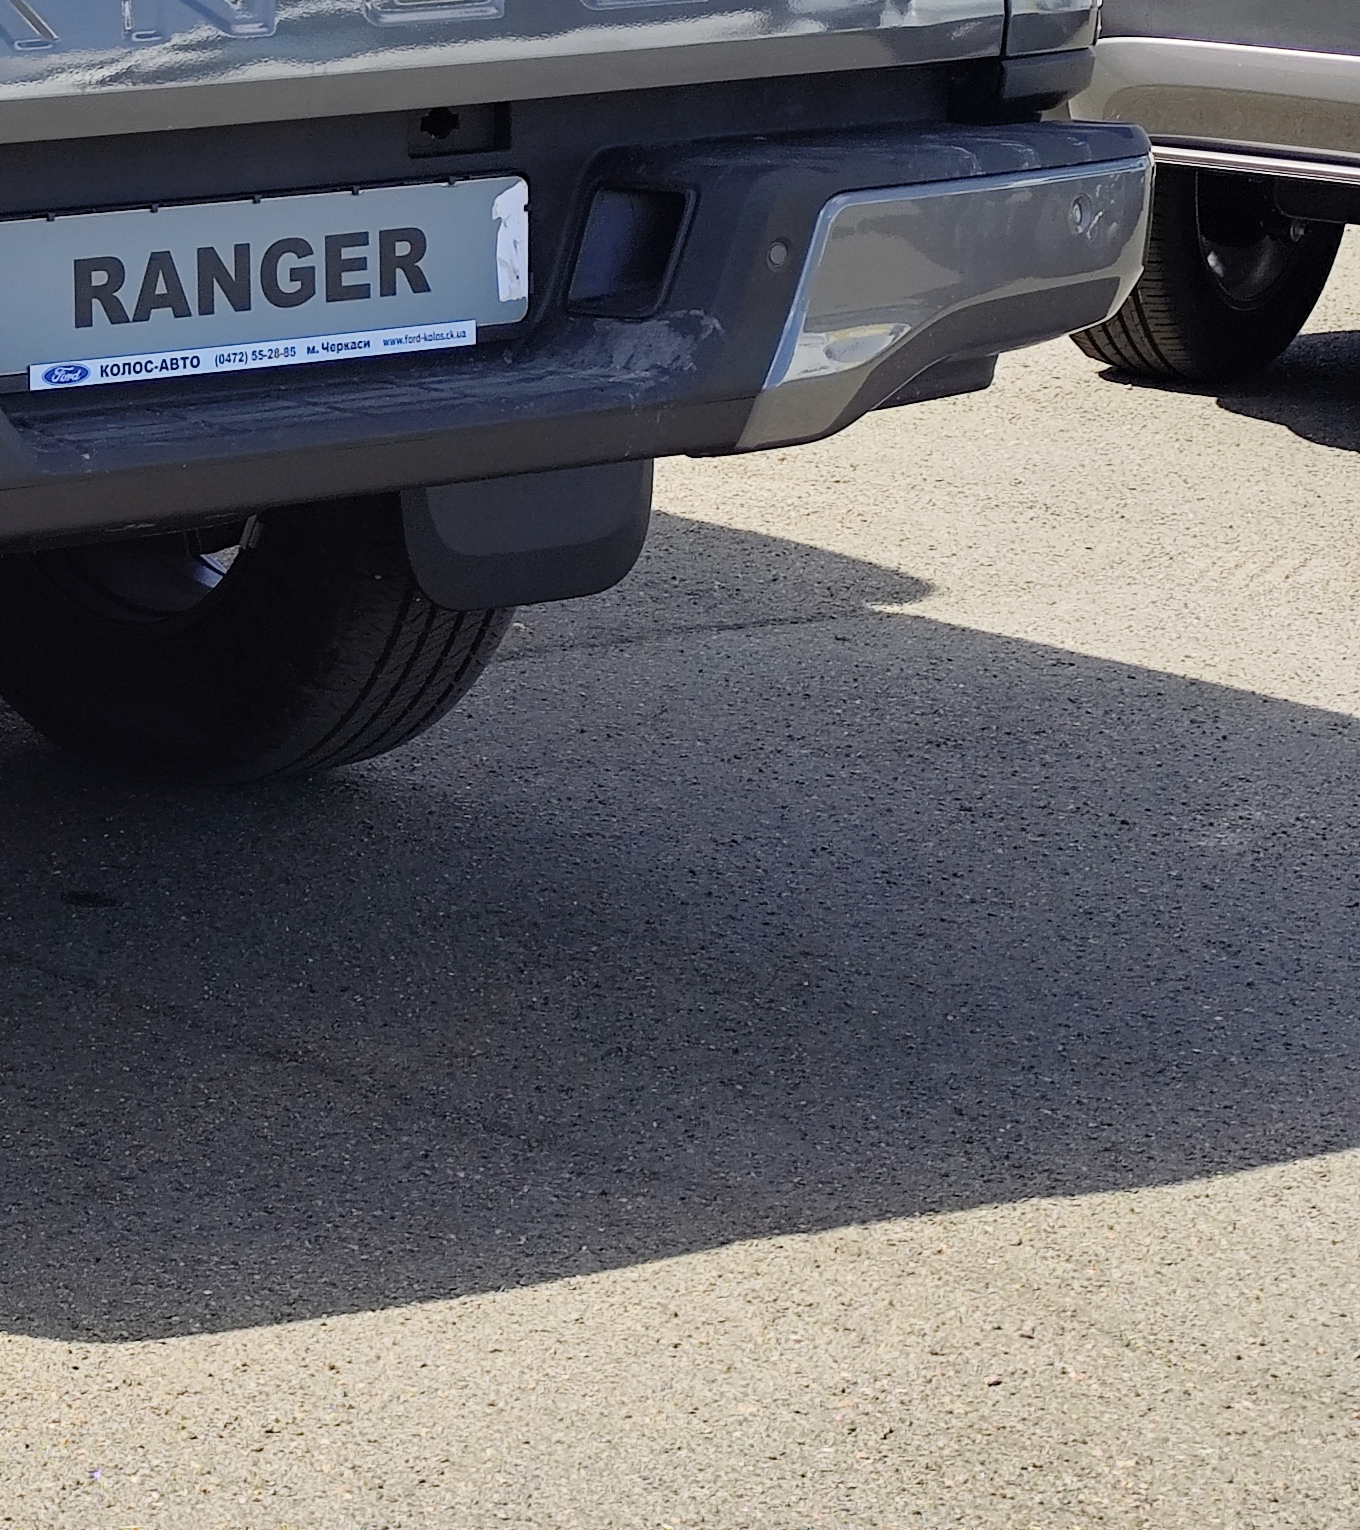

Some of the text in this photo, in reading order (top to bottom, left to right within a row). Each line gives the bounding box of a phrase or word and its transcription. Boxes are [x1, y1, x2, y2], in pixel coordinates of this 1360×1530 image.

[73, 227, 431, 328] RANGER
[50, 365, 82, 384] Ford
[100, 355, 201, 378] КОЛОС-АВТО
[214, 350, 248, 368] (0472)
[306, 345, 320, 356] м.
[321, 340, 371, 355] Черкаси
